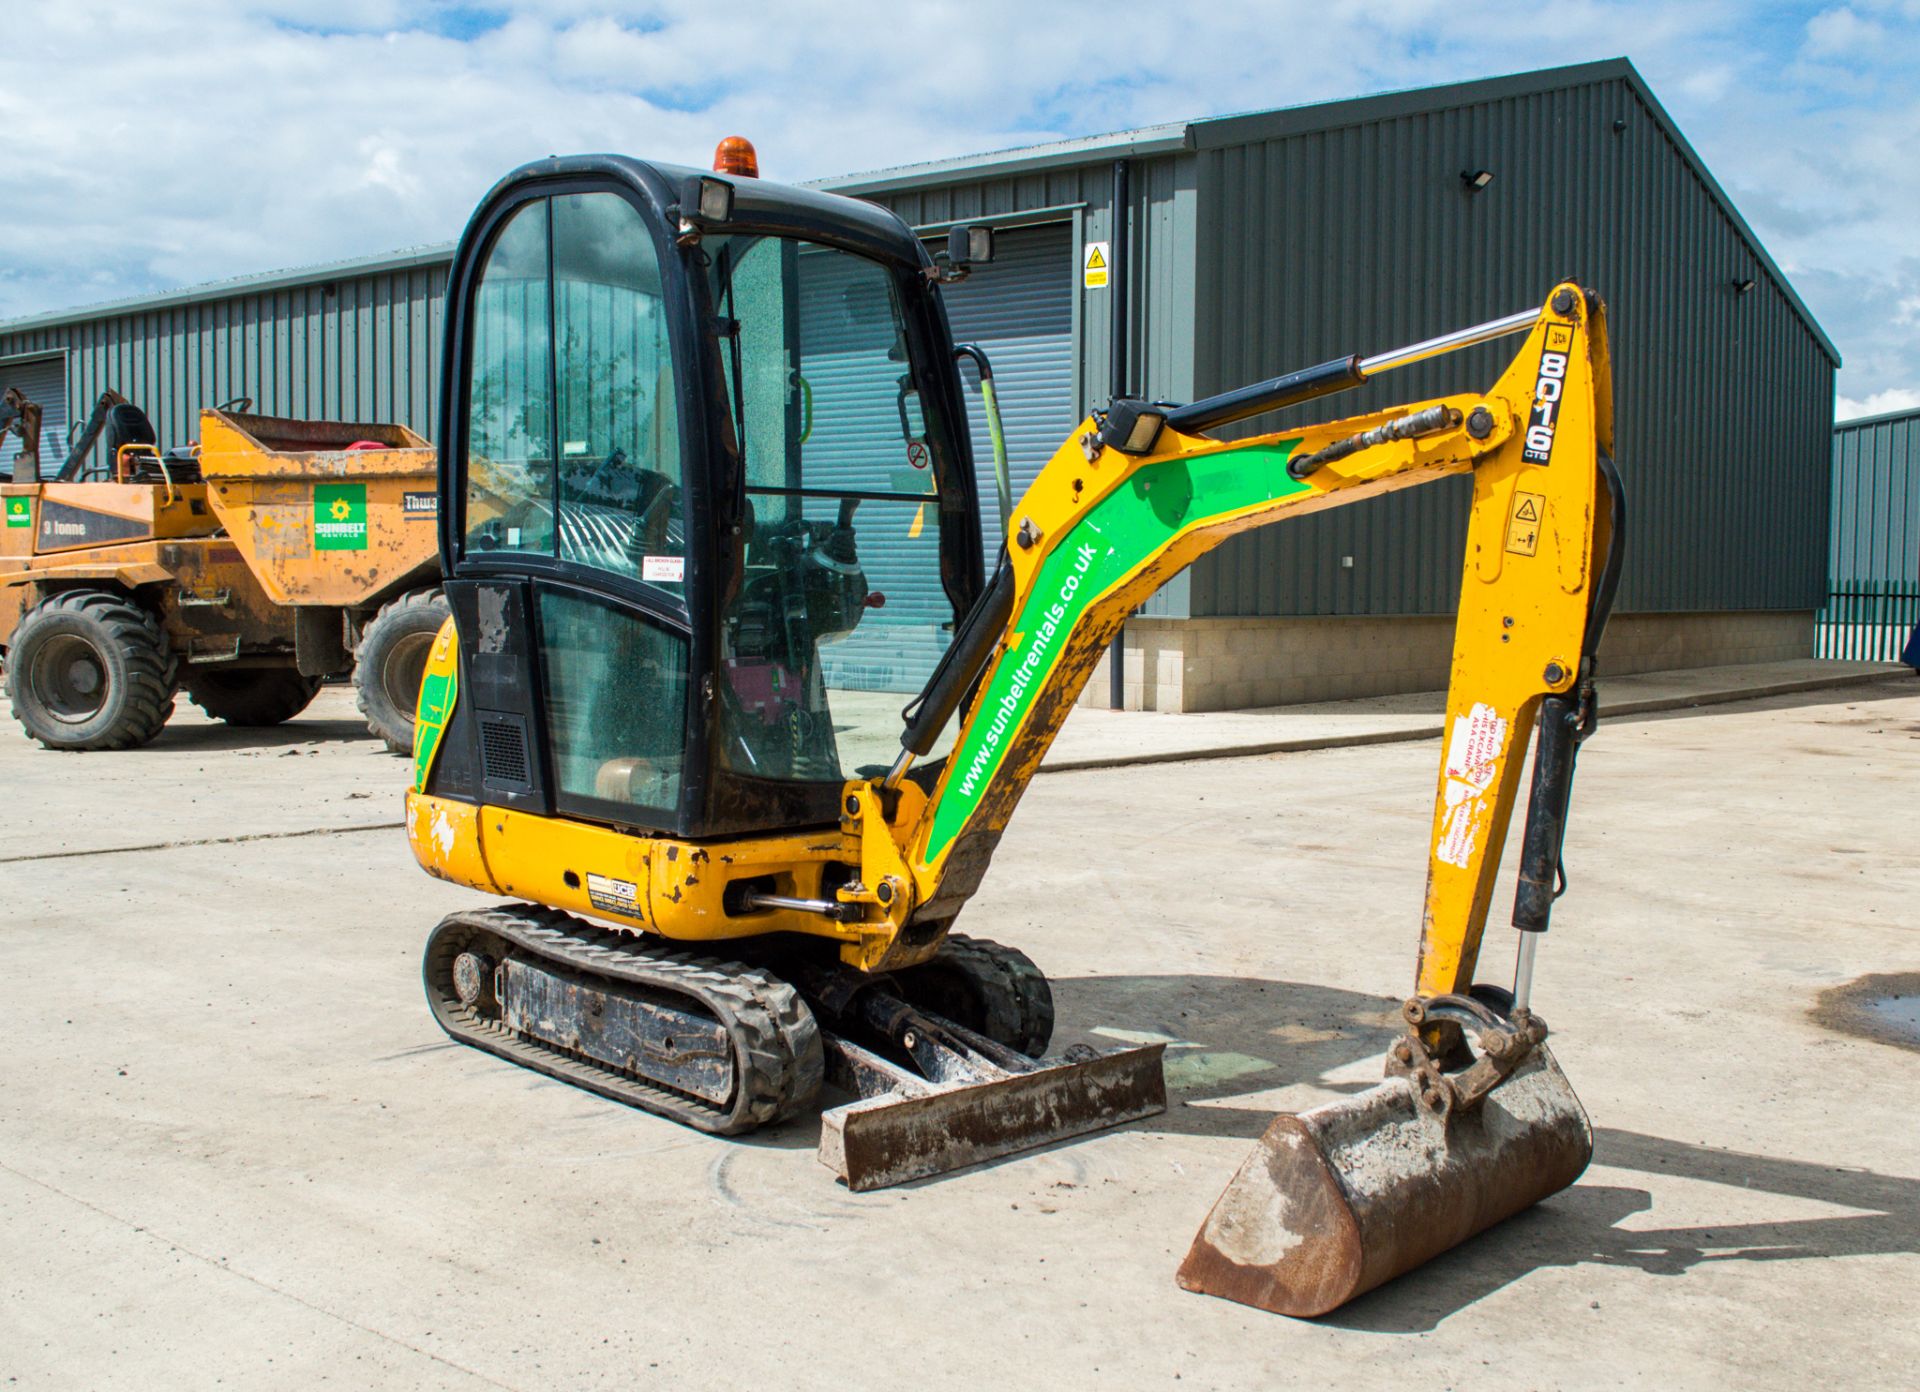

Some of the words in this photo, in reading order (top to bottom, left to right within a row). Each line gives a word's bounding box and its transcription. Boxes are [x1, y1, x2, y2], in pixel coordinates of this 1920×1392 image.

[1552, 331, 1567, 345] JCB
[1525, 352, 1567, 452] 8016
[1524, 449, 1549, 461] CTS
[405, 495, 438, 510] Thwa
[43, 520, 51, 535] 9
[54, 520, 86, 536] tonne
[314, 522, 366, 534] SUNBELT
[958, 541, 1098, 797] www.sunbeltrentals.co.uk
[1471, 717, 1479, 728] AS
[1489, 720, 1498, 735] DO
[1486, 736, 1495, 755] NOT
[612, 882, 636, 898] JCB
